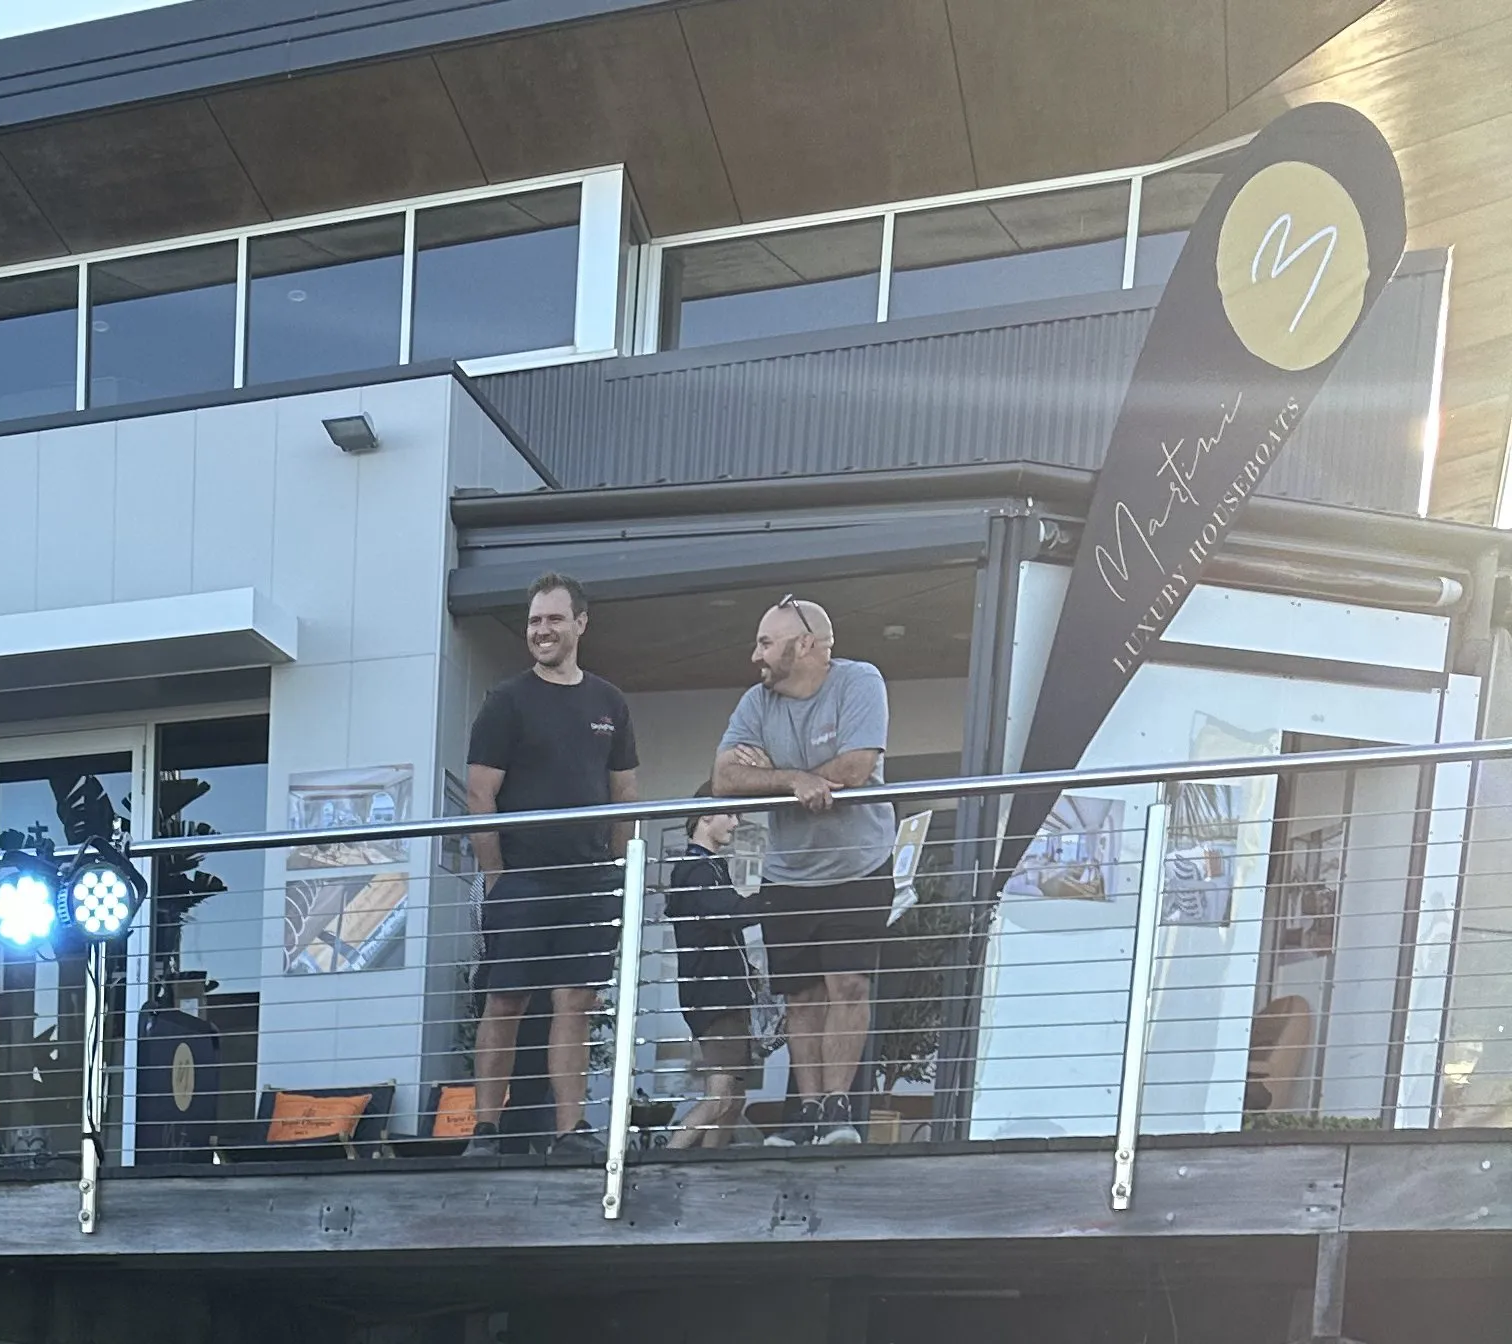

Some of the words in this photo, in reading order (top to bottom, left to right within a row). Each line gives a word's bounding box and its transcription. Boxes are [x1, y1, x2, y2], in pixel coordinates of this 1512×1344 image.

[1094, 391, 1243, 603] Martini
[1111, 563, 1189, 674] LUXURY
[1188, 395, 1300, 565] HOUSEBOATS
